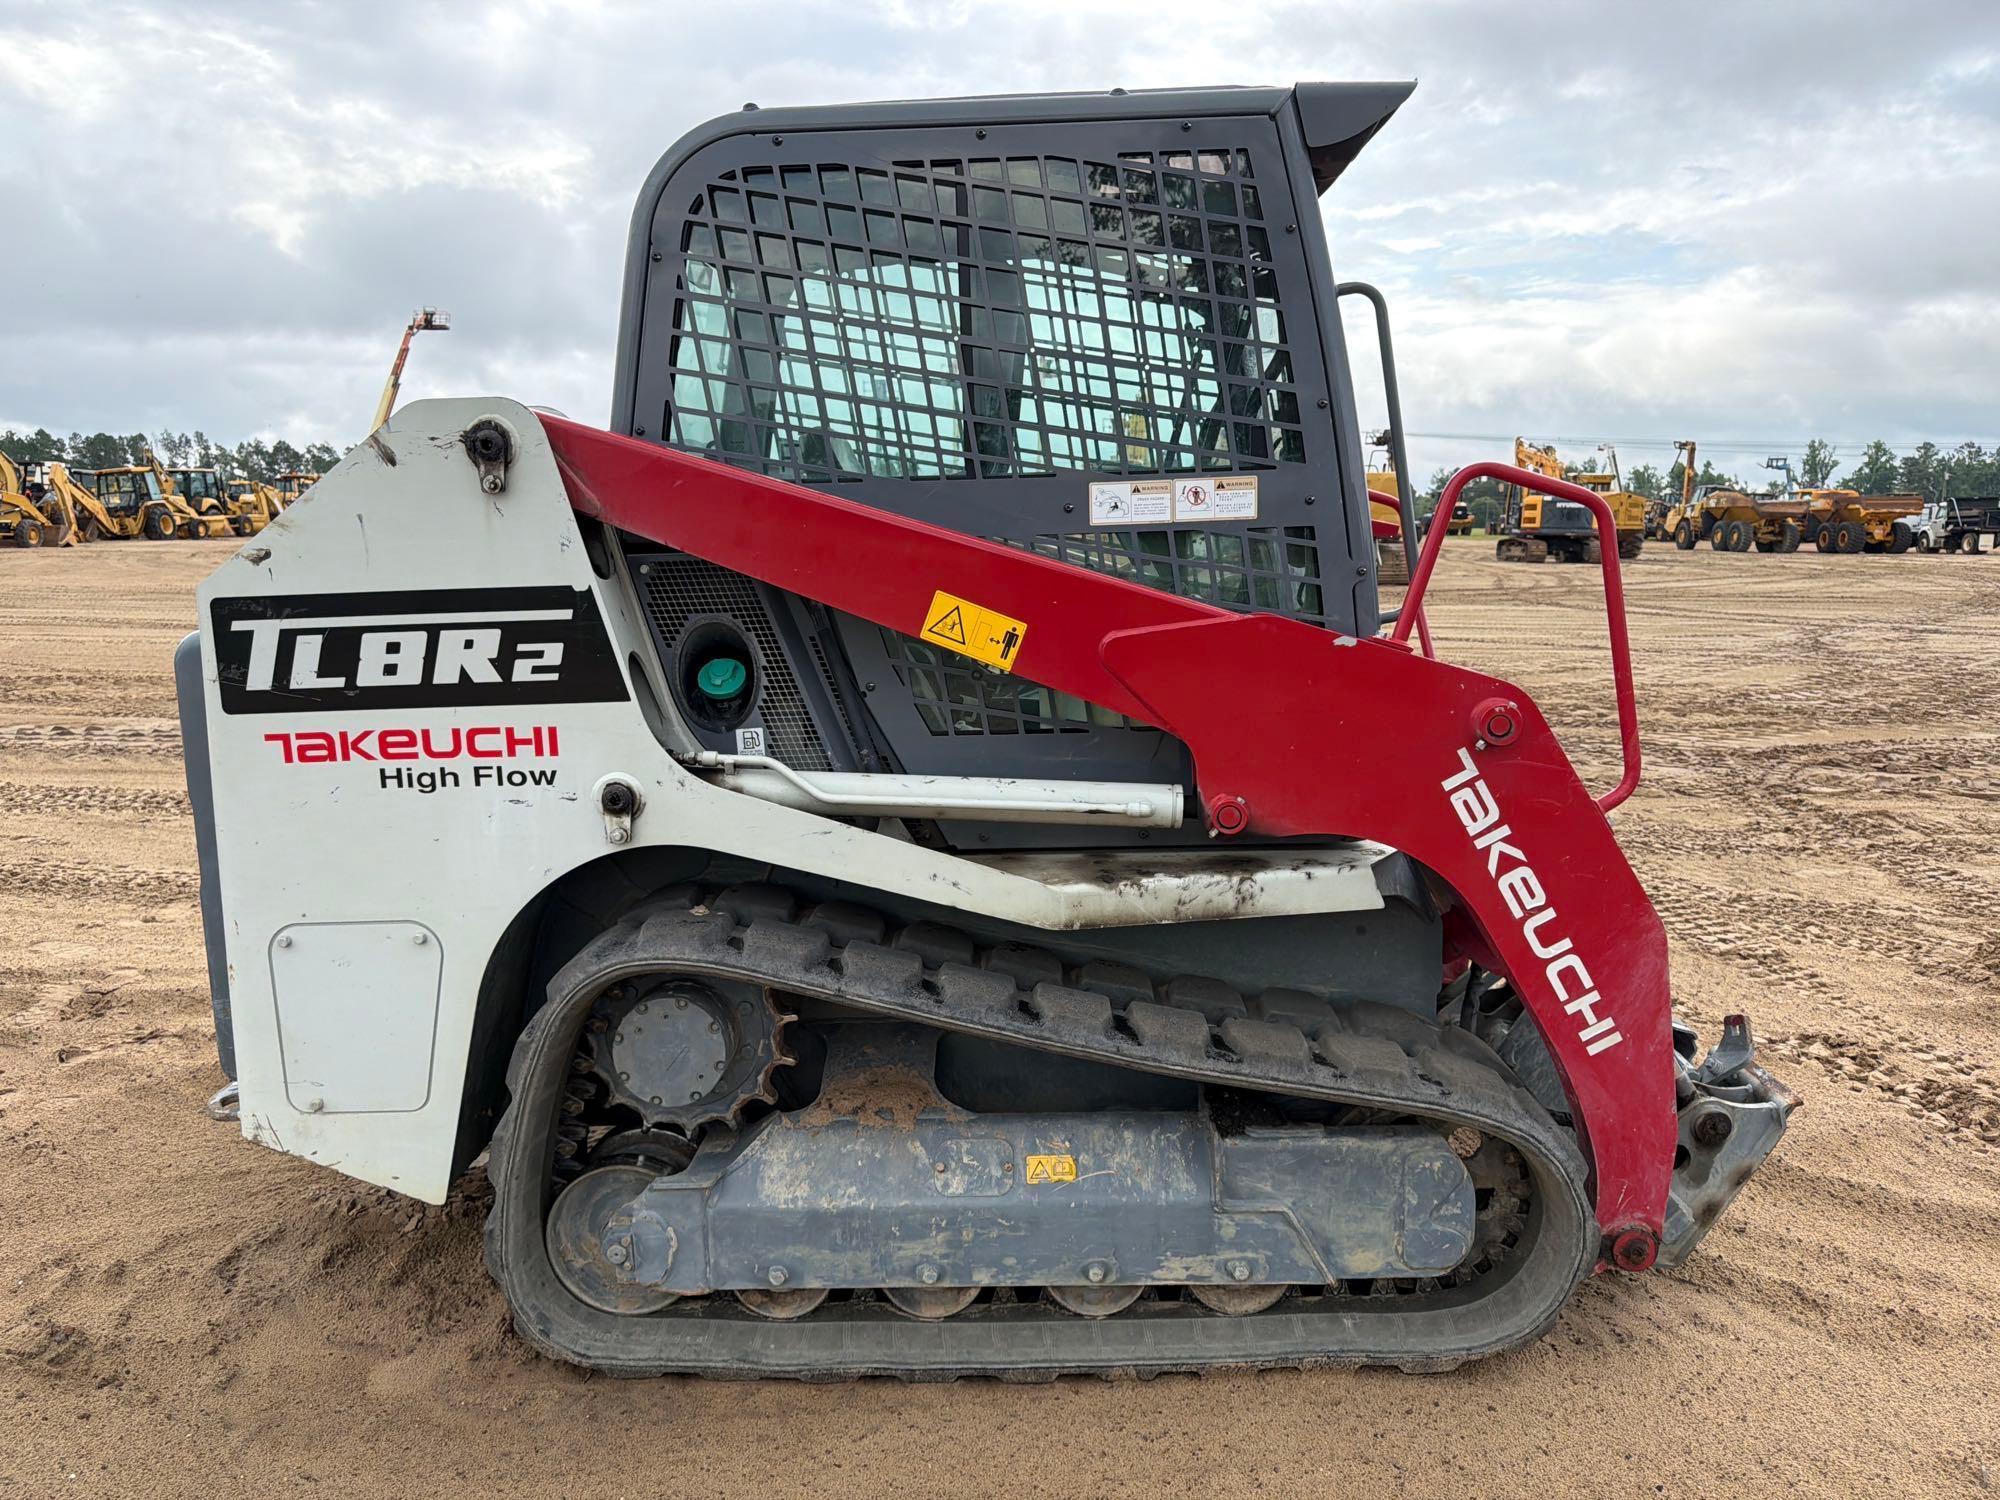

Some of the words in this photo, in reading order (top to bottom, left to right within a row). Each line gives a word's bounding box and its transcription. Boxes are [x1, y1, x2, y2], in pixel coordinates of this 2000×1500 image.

[231, 609, 573, 691] TL8R2
[264, 726, 559, 764] TAKEUCHI
[379, 767, 460, 794] High
[473, 766, 557, 787] Flow
[1441, 747, 1623, 1056] TAKEUCHI
